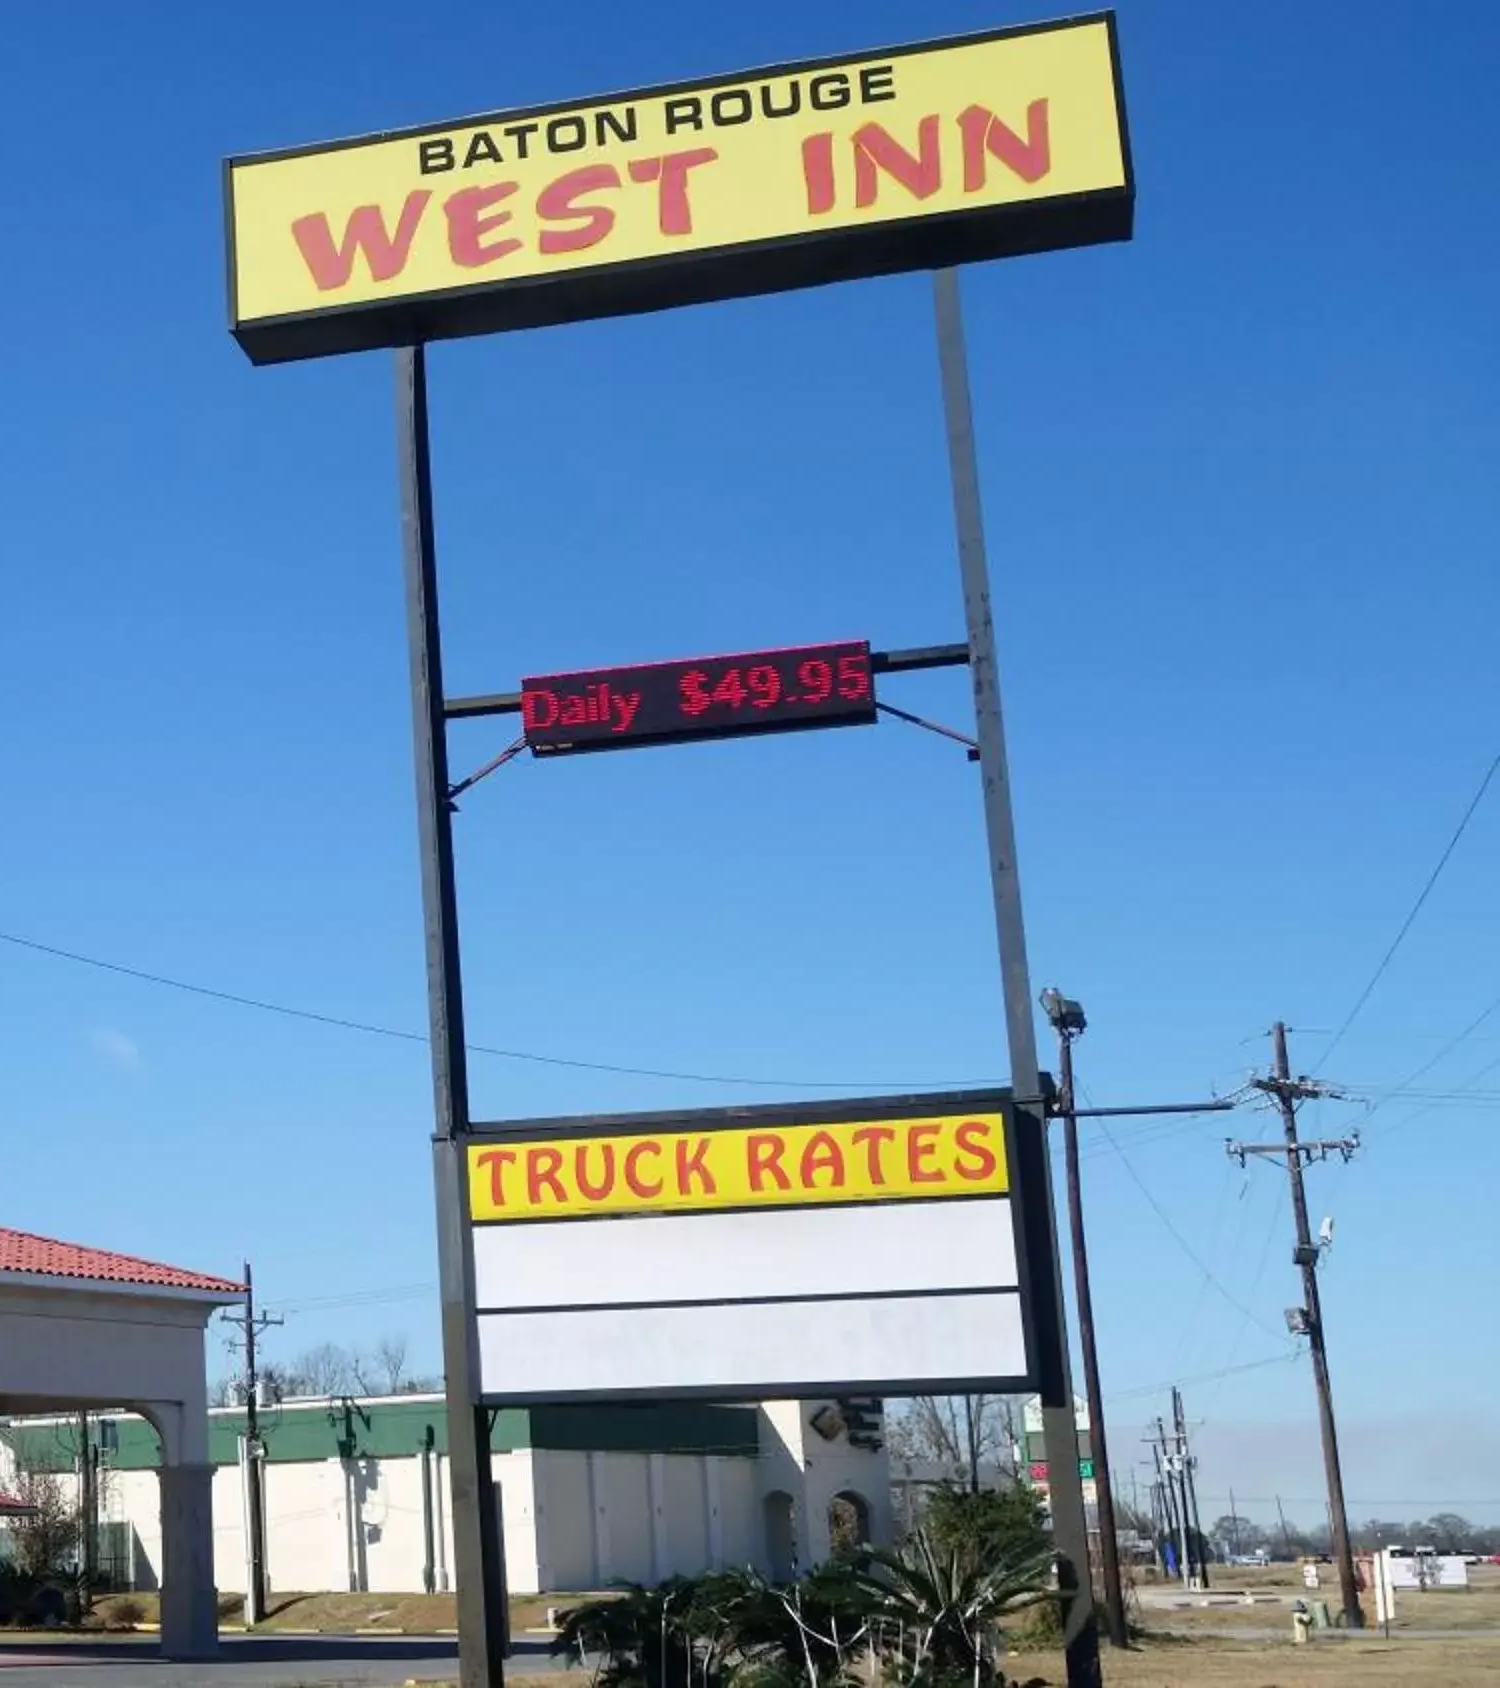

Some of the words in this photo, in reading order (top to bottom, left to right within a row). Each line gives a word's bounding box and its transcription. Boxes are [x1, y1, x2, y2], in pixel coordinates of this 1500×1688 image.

[419, 106, 638, 175] BATON
[664, 66, 897, 134] ROUGE
[291, 147, 717, 291] WEST
[801, 97, 1050, 214] INN
[521, 684, 641, 731] Daily
[679, 655, 870, 715] $49.95
[476, 1138, 717, 1206] TRUCK
[746, 1121, 997, 1191] RATES
